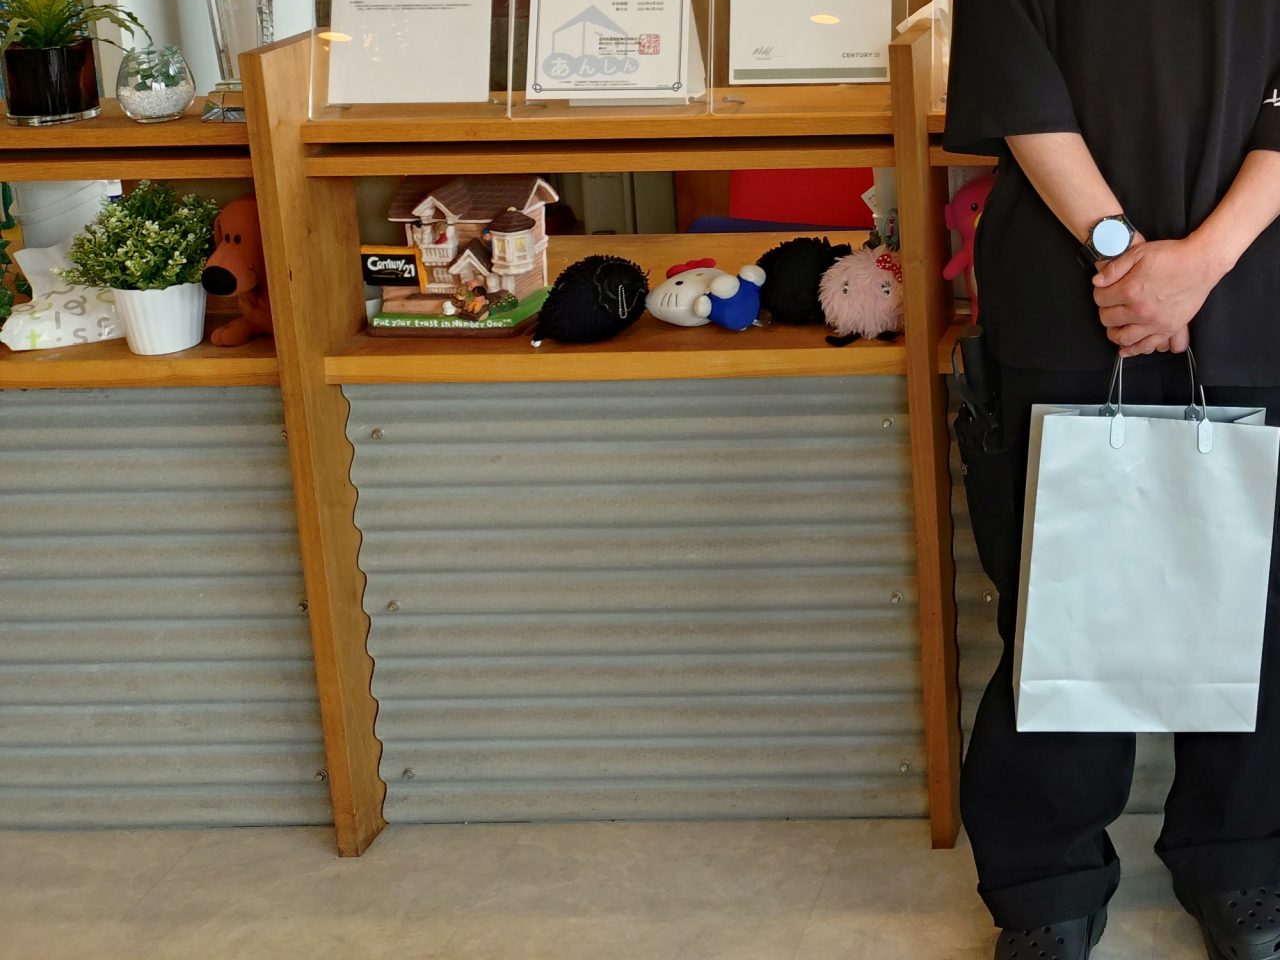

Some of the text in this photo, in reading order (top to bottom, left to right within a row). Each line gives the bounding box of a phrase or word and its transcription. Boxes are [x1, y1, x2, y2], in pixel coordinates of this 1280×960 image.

[367, 256, 416, 278] Century 21
[373, 318, 390, 326] Put
[391, 319, 411, 327] your
[415, 319, 438, 327] trust
[440, 319, 450, 327] in
[452, 319, 485, 328] Number
